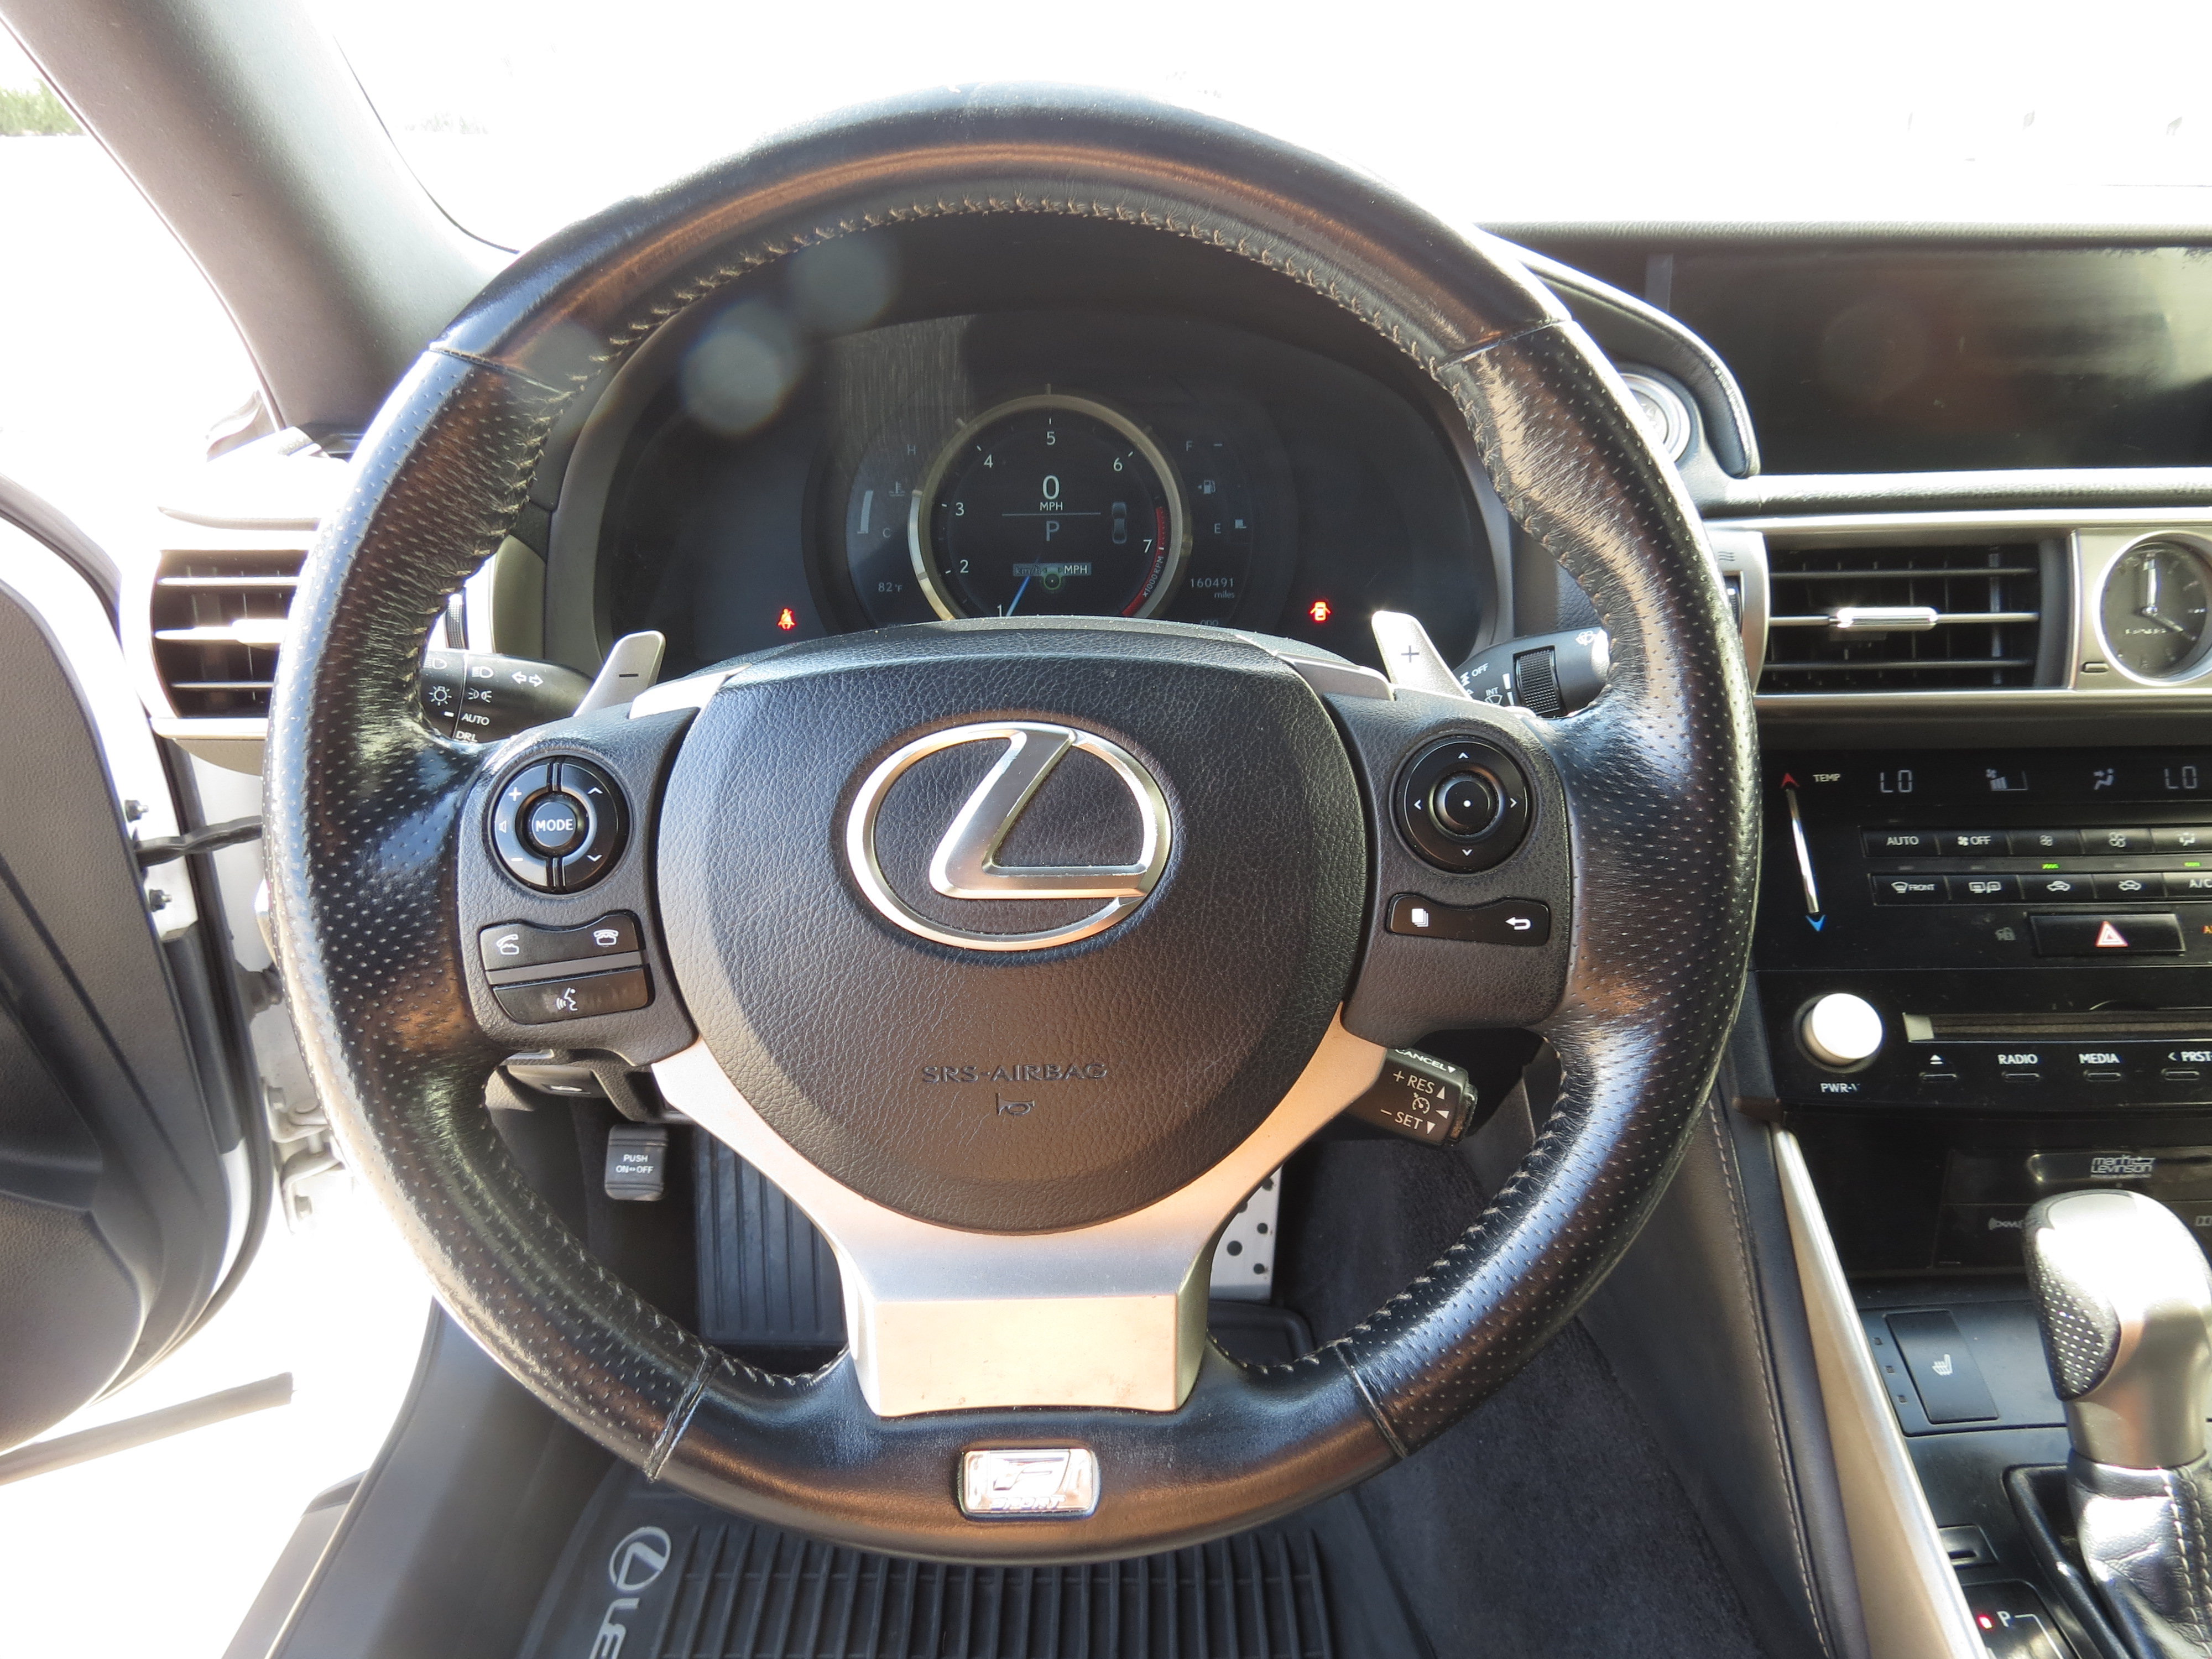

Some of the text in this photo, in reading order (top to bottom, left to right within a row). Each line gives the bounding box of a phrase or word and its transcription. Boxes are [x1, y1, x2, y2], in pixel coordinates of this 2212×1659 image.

[1046, 431, 1056, 445] 5
[907, 444, 916, 456] H
[1186, 440, 1193, 451] F
[983, 454, 994, 468] 4
[1113, 457, 1123, 471] 6
[1042, 475, 1060, 499] 0
[955, 502, 964, 516] 3
[1040, 502, 1063, 511] MPH
[883, 528, 891, 539] C
[1046, 520, 1060, 541] P
[1214, 523, 1221, 534] E
[1143, 539, 1153, 553] 7
[959, 560, 969, 573] 2
[1064, 565, 1087, 575] MPH
[1191, 578, 1234, 588] 160491
[1214, 590, 1235, 598] miles
[1471, 662, 1489, 677] OFF
[1485, 687, 1499, 697] INT
[461, 712, 490, 726] AUTO
[456, 730, 478, 742] DRL
[1813, 773, 1841, 782] TEMP
[1880, 769, 1912, 793] LO
[2164, 765, 2198, 790] LO
[535, 818, 573, 832] MODE
[1886, 836, 1919, 846] AUTO
[1970, 836, 1991, 846] OFF
[2188, 878, 2212, 889] A/C
[1997, 1053, 2038, 1065] RADIO
[2079, 1053, 2120, 1064] MEDIA
[1407, 1074, 1435, 1094] RES
[1394, 1112, 1423, 1130] SET
[623, 1154, 649, 1162] PUSH
[1997, 1610, 2011, 1627] P
